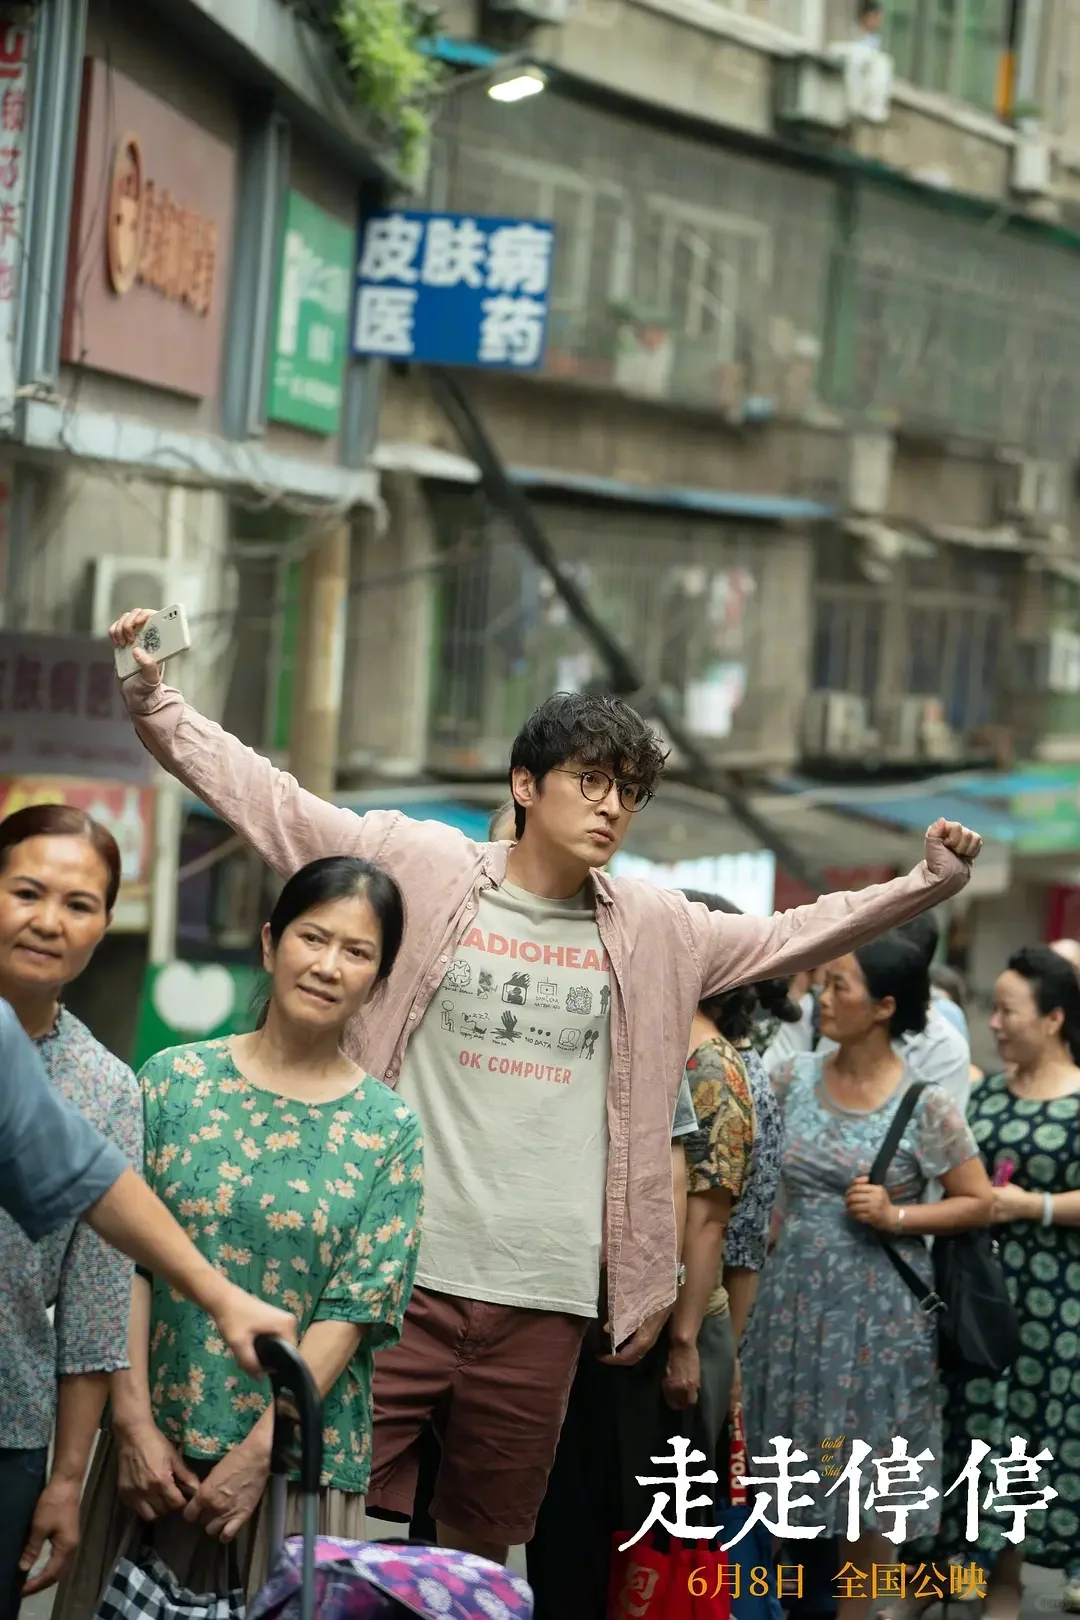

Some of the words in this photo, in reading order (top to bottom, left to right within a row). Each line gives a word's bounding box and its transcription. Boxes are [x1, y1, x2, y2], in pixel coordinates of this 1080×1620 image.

[358, 214, 554, 294] 皮肤病
[456, 927, 612, 972] ADIOHEA
[534, 1040, 552, 1049] DATA
[459, 1050, 483, 1069] OK
[488, 1056, 572, 1085] COMPUTER
